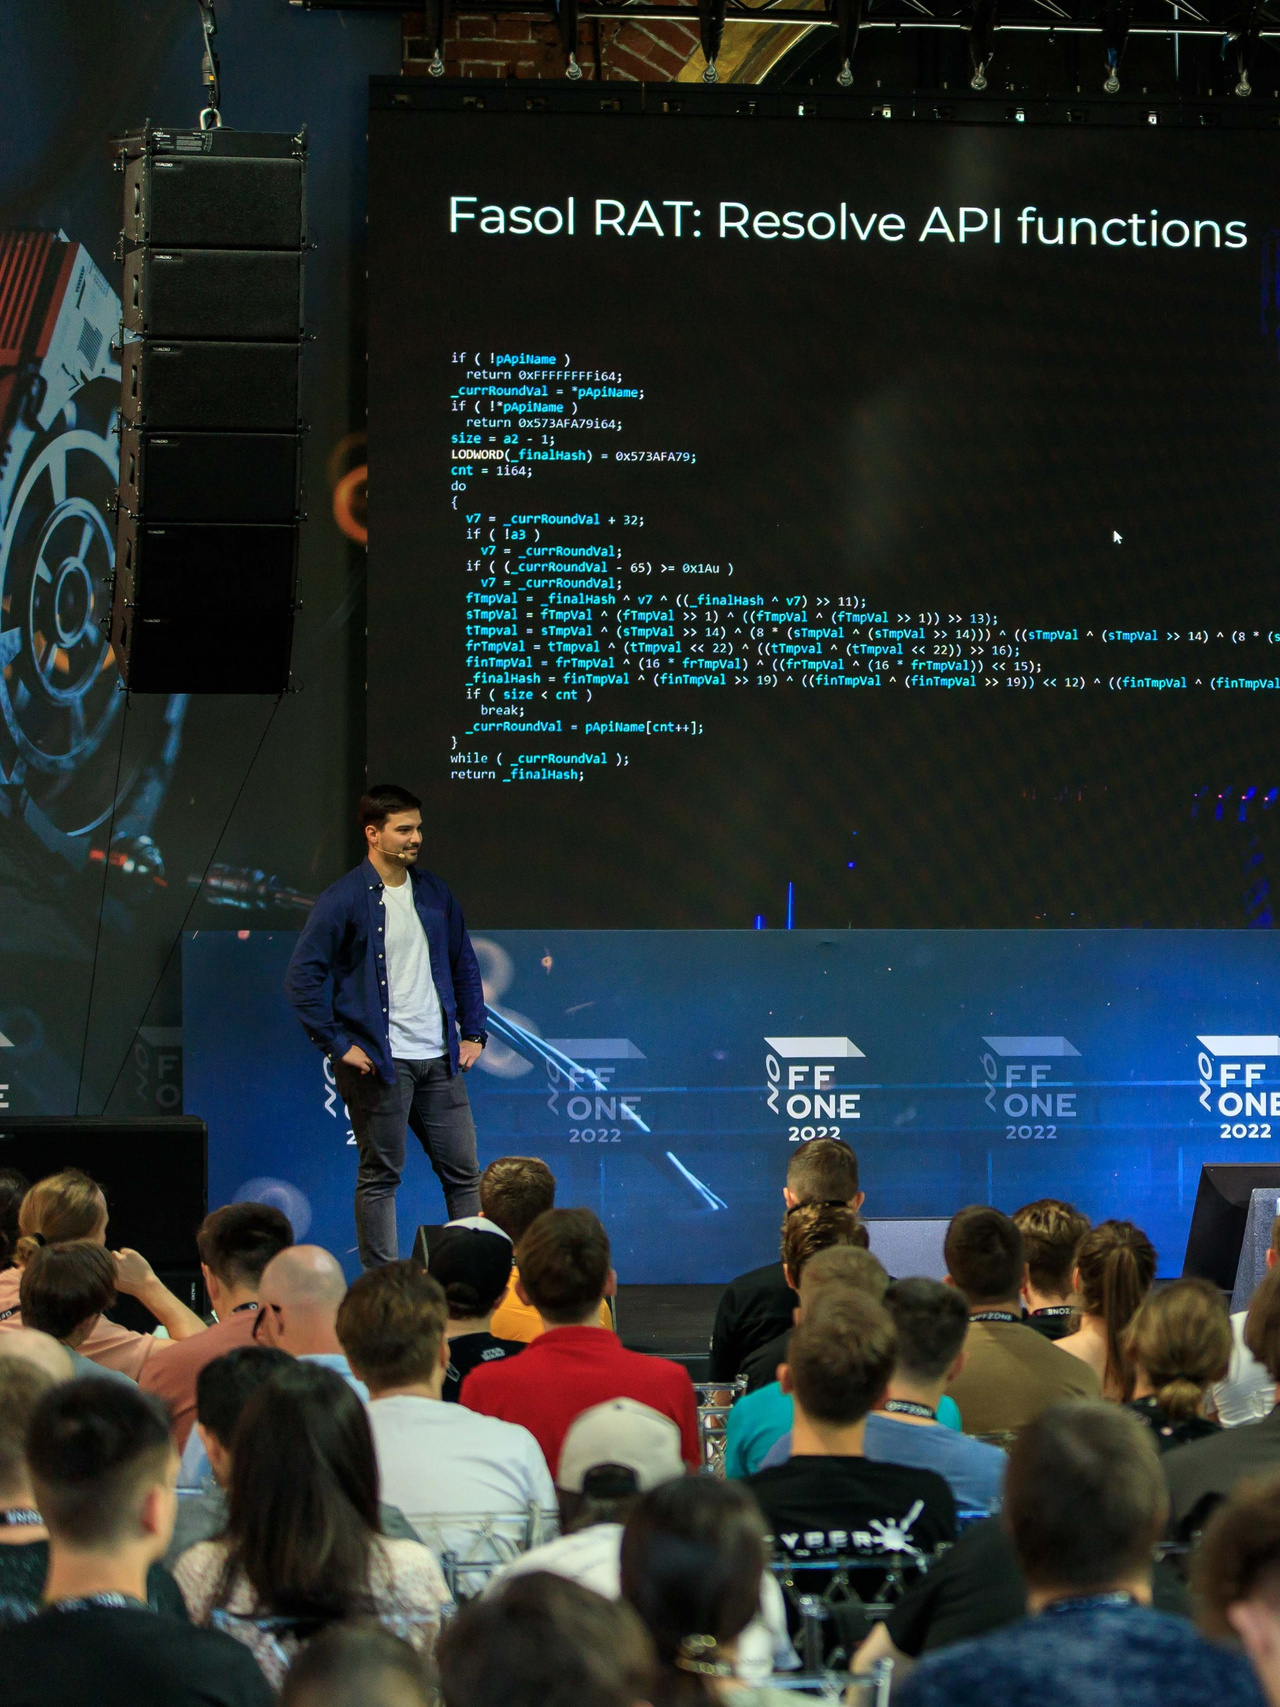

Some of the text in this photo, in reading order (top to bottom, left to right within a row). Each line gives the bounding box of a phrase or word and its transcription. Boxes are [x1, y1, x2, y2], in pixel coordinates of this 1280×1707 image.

[451, 197, 1247, 248] Fasol RAT: Resolve API functions
[452, 351, 466, 363] if
[467, 369, 511, 379] return
[452, 400, 466, 412] if
[467, 417, 511, 427] return
[451, 431, 481, 444] size
[503, 434, 518, 445] a2
[451, 464, 473, 476] cnt
[451, 480, 466, 491] do
[466, 512, 481, 523] v7
[467, 527, 480, 540] if
[481, 545, 496, 555] v7
[467, 559, 480, 571] if
[683, 562, 719, 573] 0x1Au
[481, 576, 496, 588] v7
[466, 591, 518, 606] fTmpVal
[638, 594, 653, 605] v7
[466, 607, 518, 622] sTmpVal
[541, 608, 592, 623] fTmpVal
[542, 624, 592, 639] sTmpVal
[466, 639, 525, 654] frTmpVal
[466, 655, 532, 670] finTmpVal
[556, 656, 614, 671] frTmpVal
[563, 672, 629, 687] finTmpVal
[467, 687, 577, 701] if size cnt
[451, 751, 487, 764] while
[451, 769, 495, 779] return
[569, 1128, 621, 1142] 2022
[788, 1126, 840, 1141] 2022
[1006, 1125, 1057, 1139] 2022
[1220, 1124, 1271, 1138] 2022
